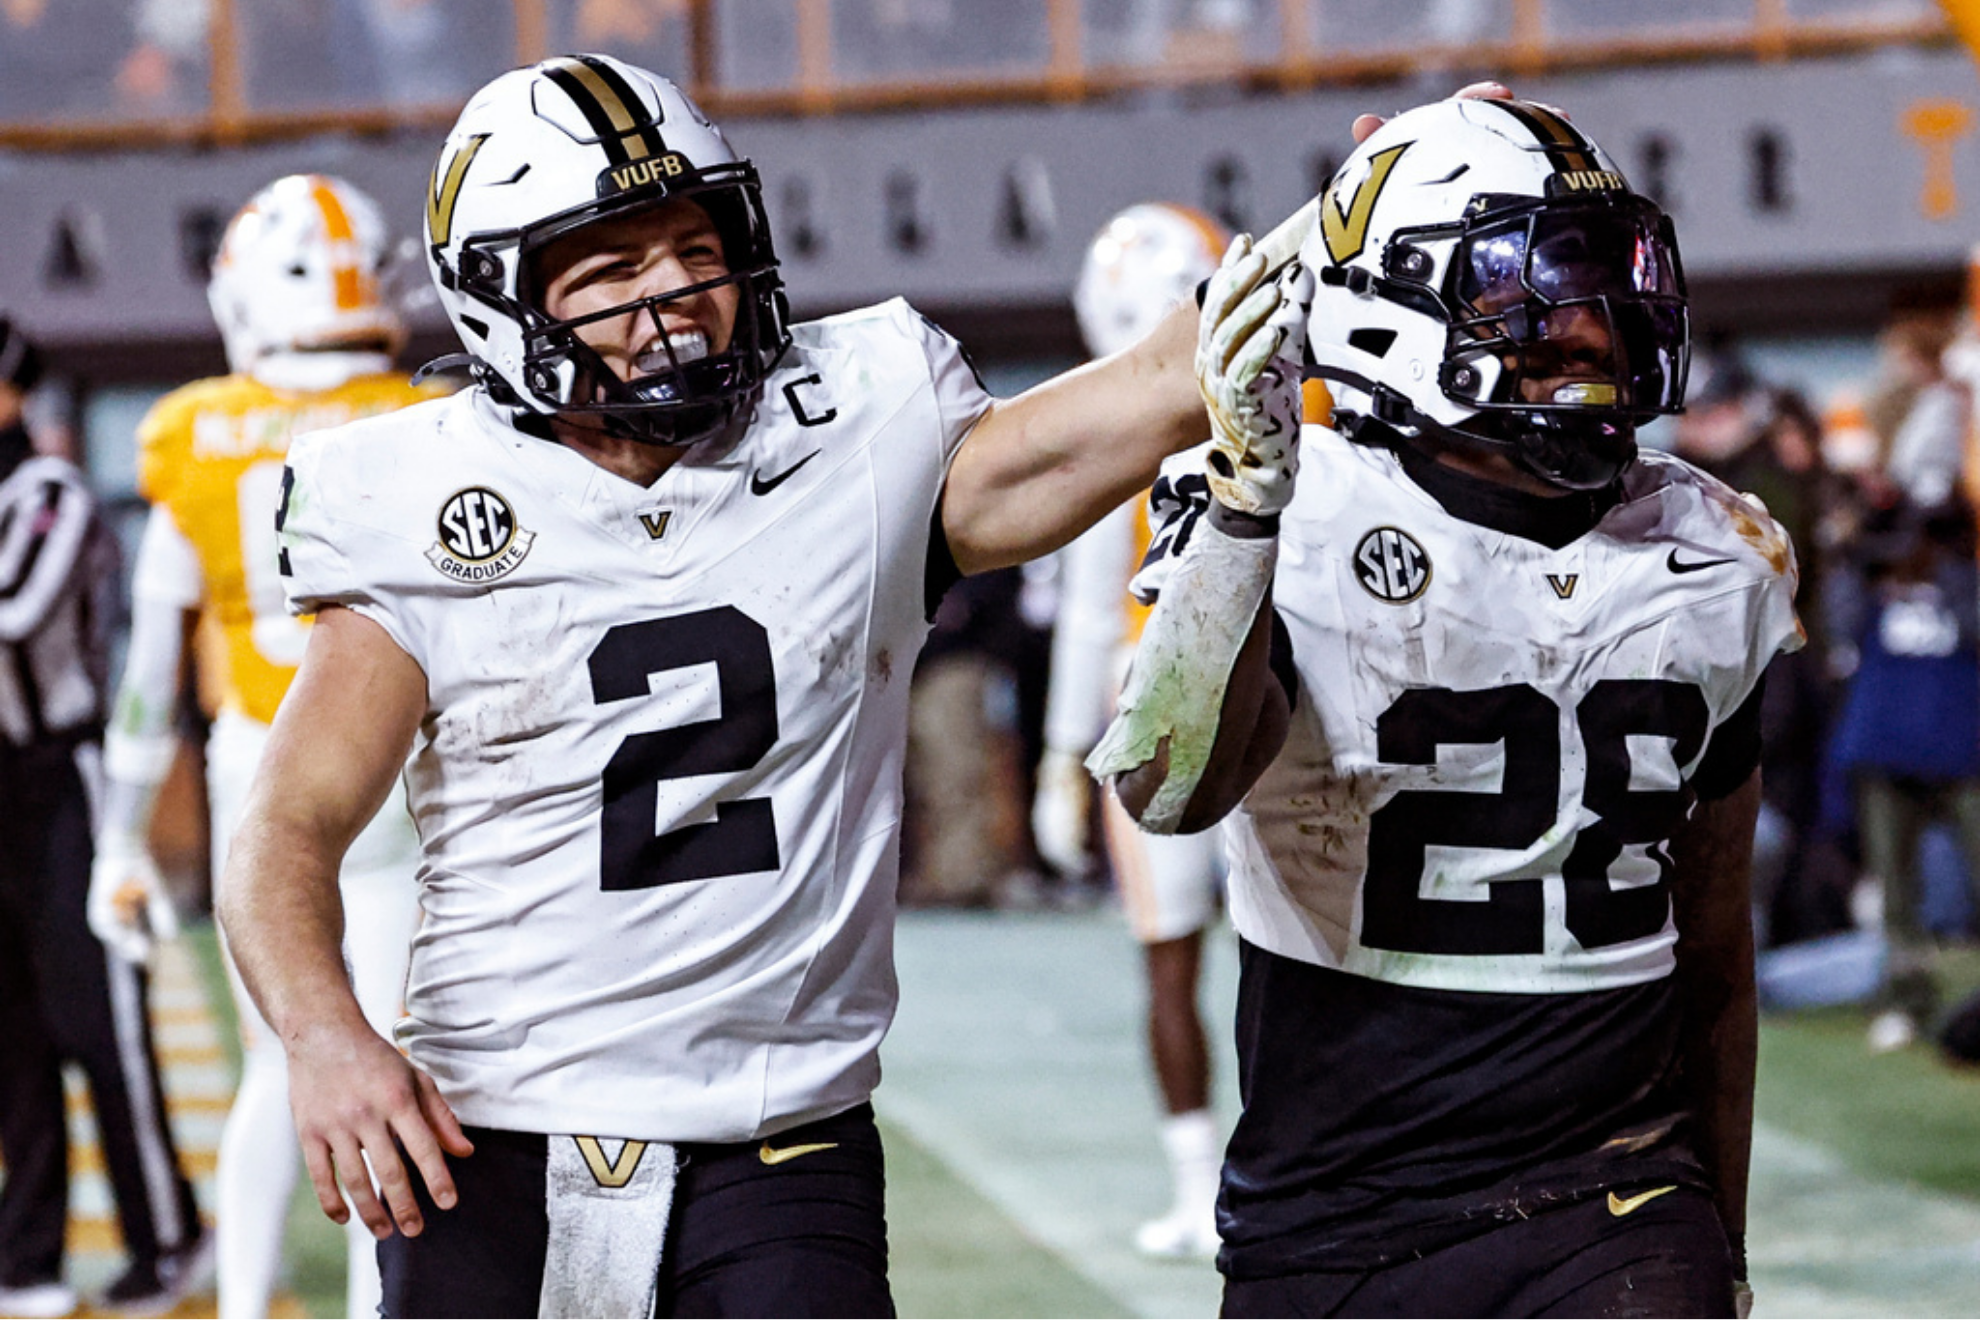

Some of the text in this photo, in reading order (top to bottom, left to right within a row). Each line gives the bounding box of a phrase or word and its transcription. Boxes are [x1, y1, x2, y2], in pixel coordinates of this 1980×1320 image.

[611, 154, 683, 190] VUFB
[1320, 139, 1418, 267] V
[782, 372, 838, 427] C
[442, 491, 509, 557] SEC
[637, 510, 672, 540] V
[440, 545, 522, 580] GRADUATE
[1359, 529, 1425, 598] SEC
[1545, 574, 1578, 599] V
[587, 604, 780, 892] 2
[1359, 679, 1710, 956] 28
[571, 1135, 649, 1188] V
